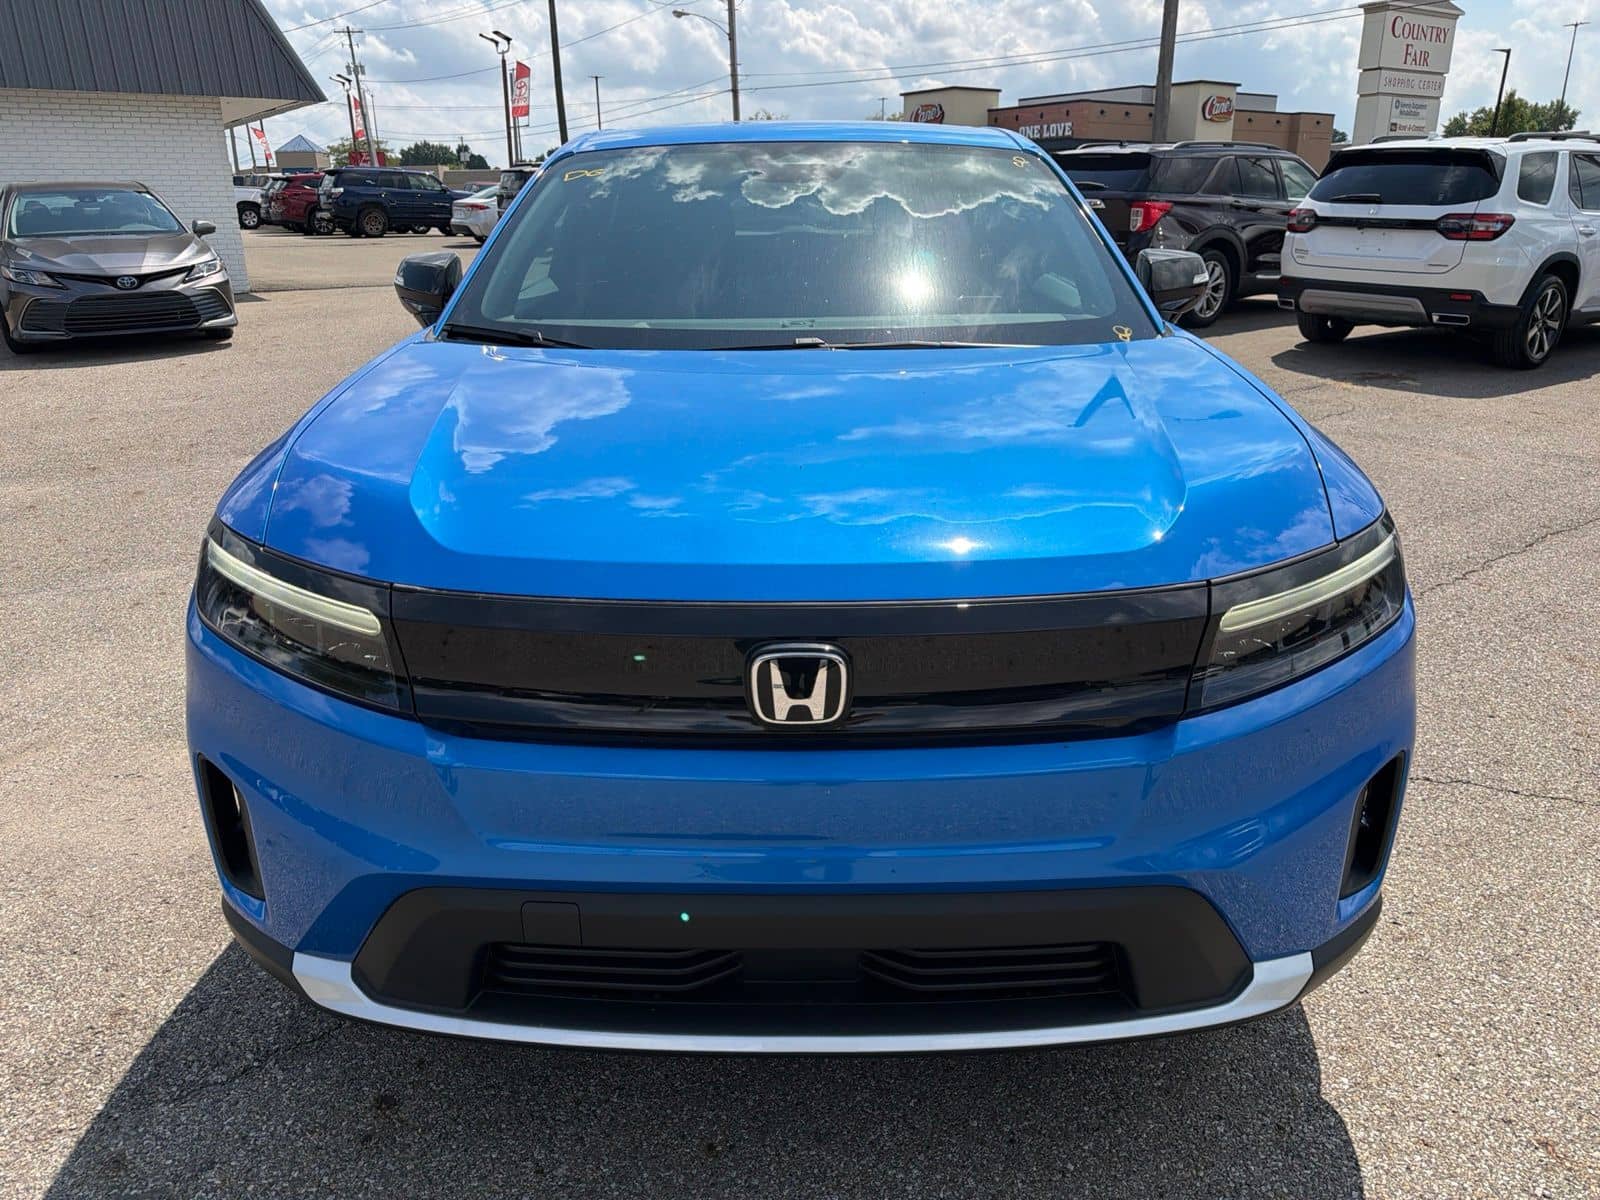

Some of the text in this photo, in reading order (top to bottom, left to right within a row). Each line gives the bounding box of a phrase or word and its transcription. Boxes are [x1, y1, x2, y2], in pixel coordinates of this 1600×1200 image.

[1391, 15, 1450, 44] COUNTRY
[1403, 44, 1430, 67] FAIR
[1384, 76, 1442, 92] SHOPPING CENTER
[1019, 122, 1073, 139] ONE LOVE
